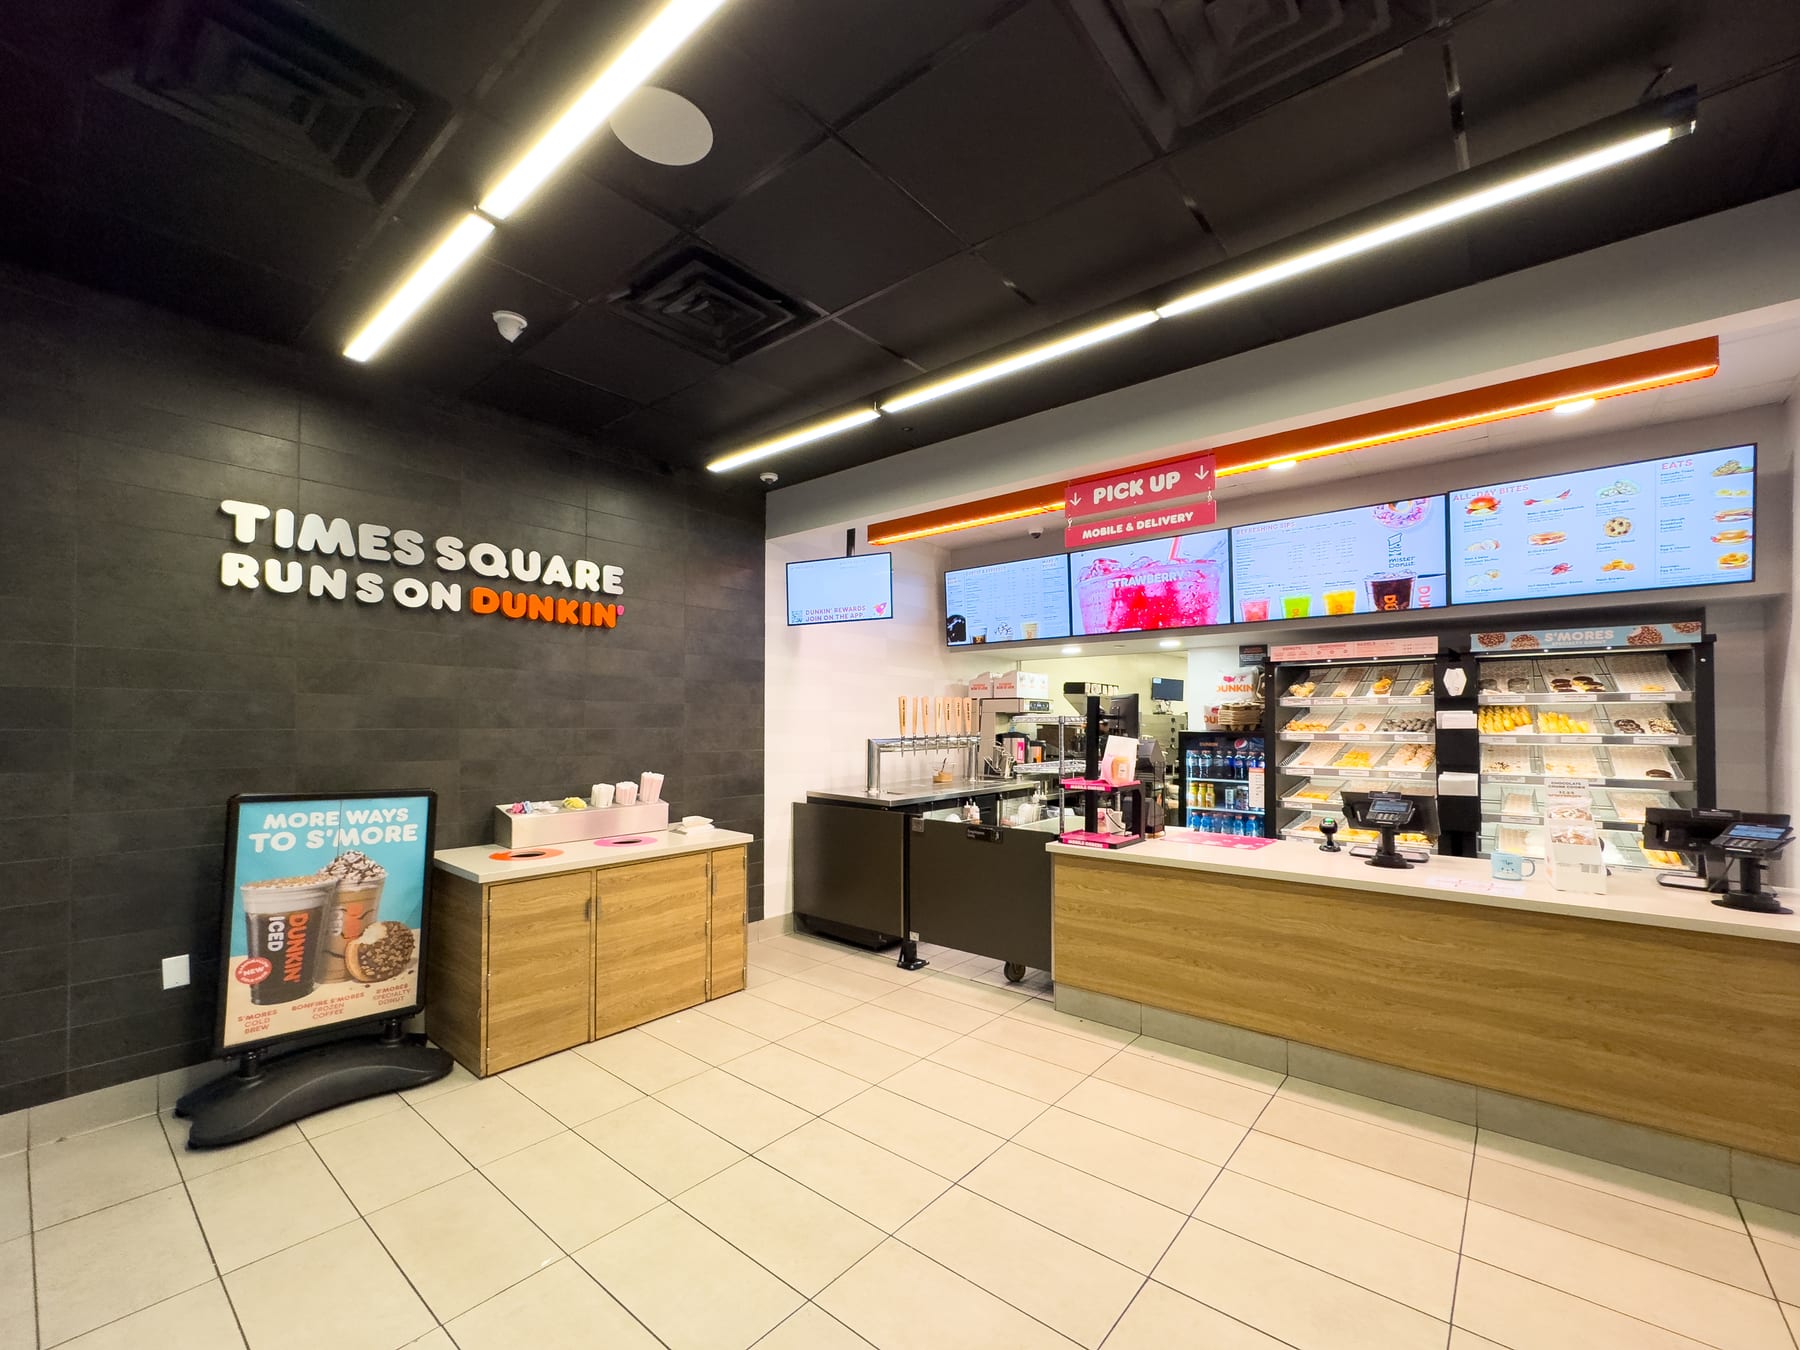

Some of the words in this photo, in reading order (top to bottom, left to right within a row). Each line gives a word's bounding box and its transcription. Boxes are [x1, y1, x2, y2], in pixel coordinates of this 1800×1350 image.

[1661, 459, 1693, 470] EATS
[1093, 478, 1144, 505] PICK
[1149, 471, 1181, 492] UP
[1499, 484, 1529, 495] BITES
[1082, 524, 1123, 540] MOBILE
[1125, 522, 1134, 532] &
[1136, 511, 1194, 531] DELIVERY
[220, 500, 426, 567] TIMES
[435, 535, 625, 596] SQUARE
[221, 552, 385, 605] RUNS
[392, 577, 463, 613] ON
[469, 586, 626, 629] DUNKIN'
[1544, 629, 1615, 642] S'MORES
[263, 811, 339, 830] MORE
[346, 808, 409, 825] WAYS
[249, 831, 297, 853] TO
[306, 824, 419, 849] S'MORE
[267, 916, 286, 952] ICED
[283, 912, 310, 983] DUNKIN
[243, 966, 265, 977] NEW
[312, 1003, 345, 1014] FROZEN
[312, 1009, 344, 1020] COFFEE
[244, 1017, 271, 1028] COLD
[244, 1024, 270, 1034] BREW
